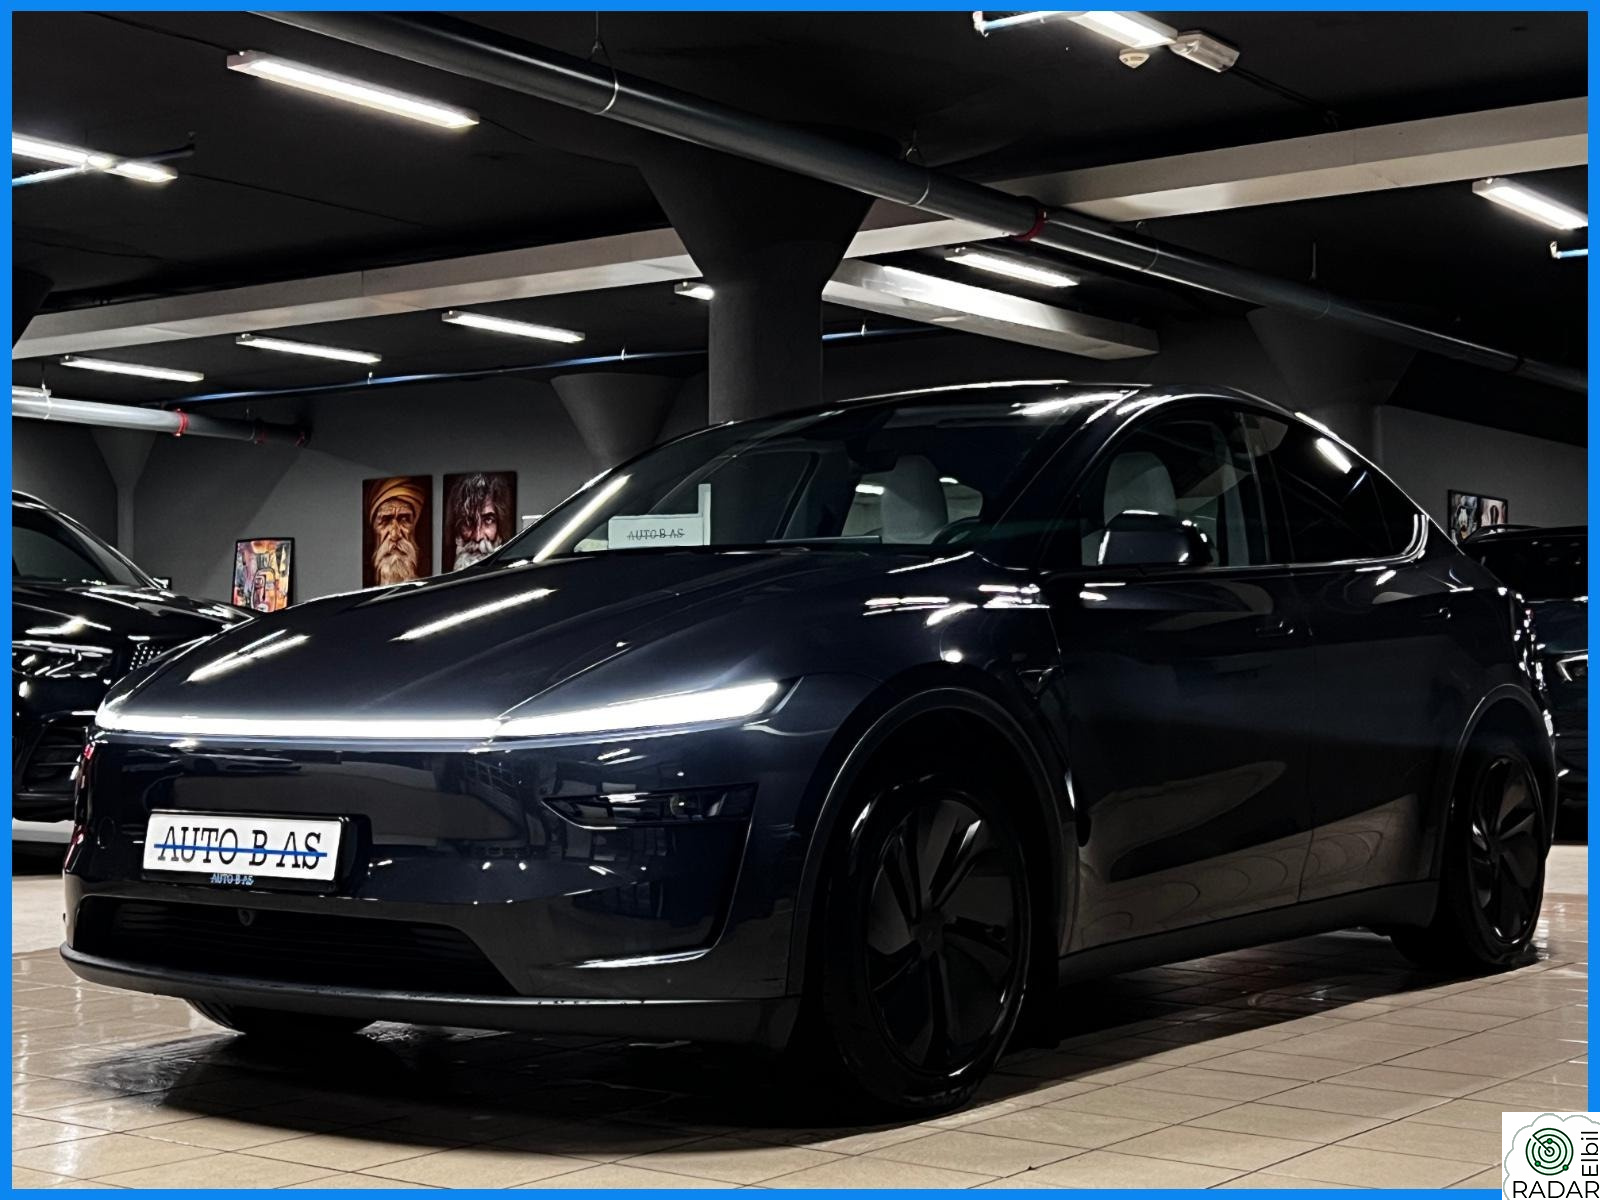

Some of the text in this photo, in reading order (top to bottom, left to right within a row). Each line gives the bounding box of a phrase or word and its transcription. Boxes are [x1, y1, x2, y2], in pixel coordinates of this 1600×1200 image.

[157, 826, 321, 870] AUTO B AS
[210, 873, 234, 884] AUTO
